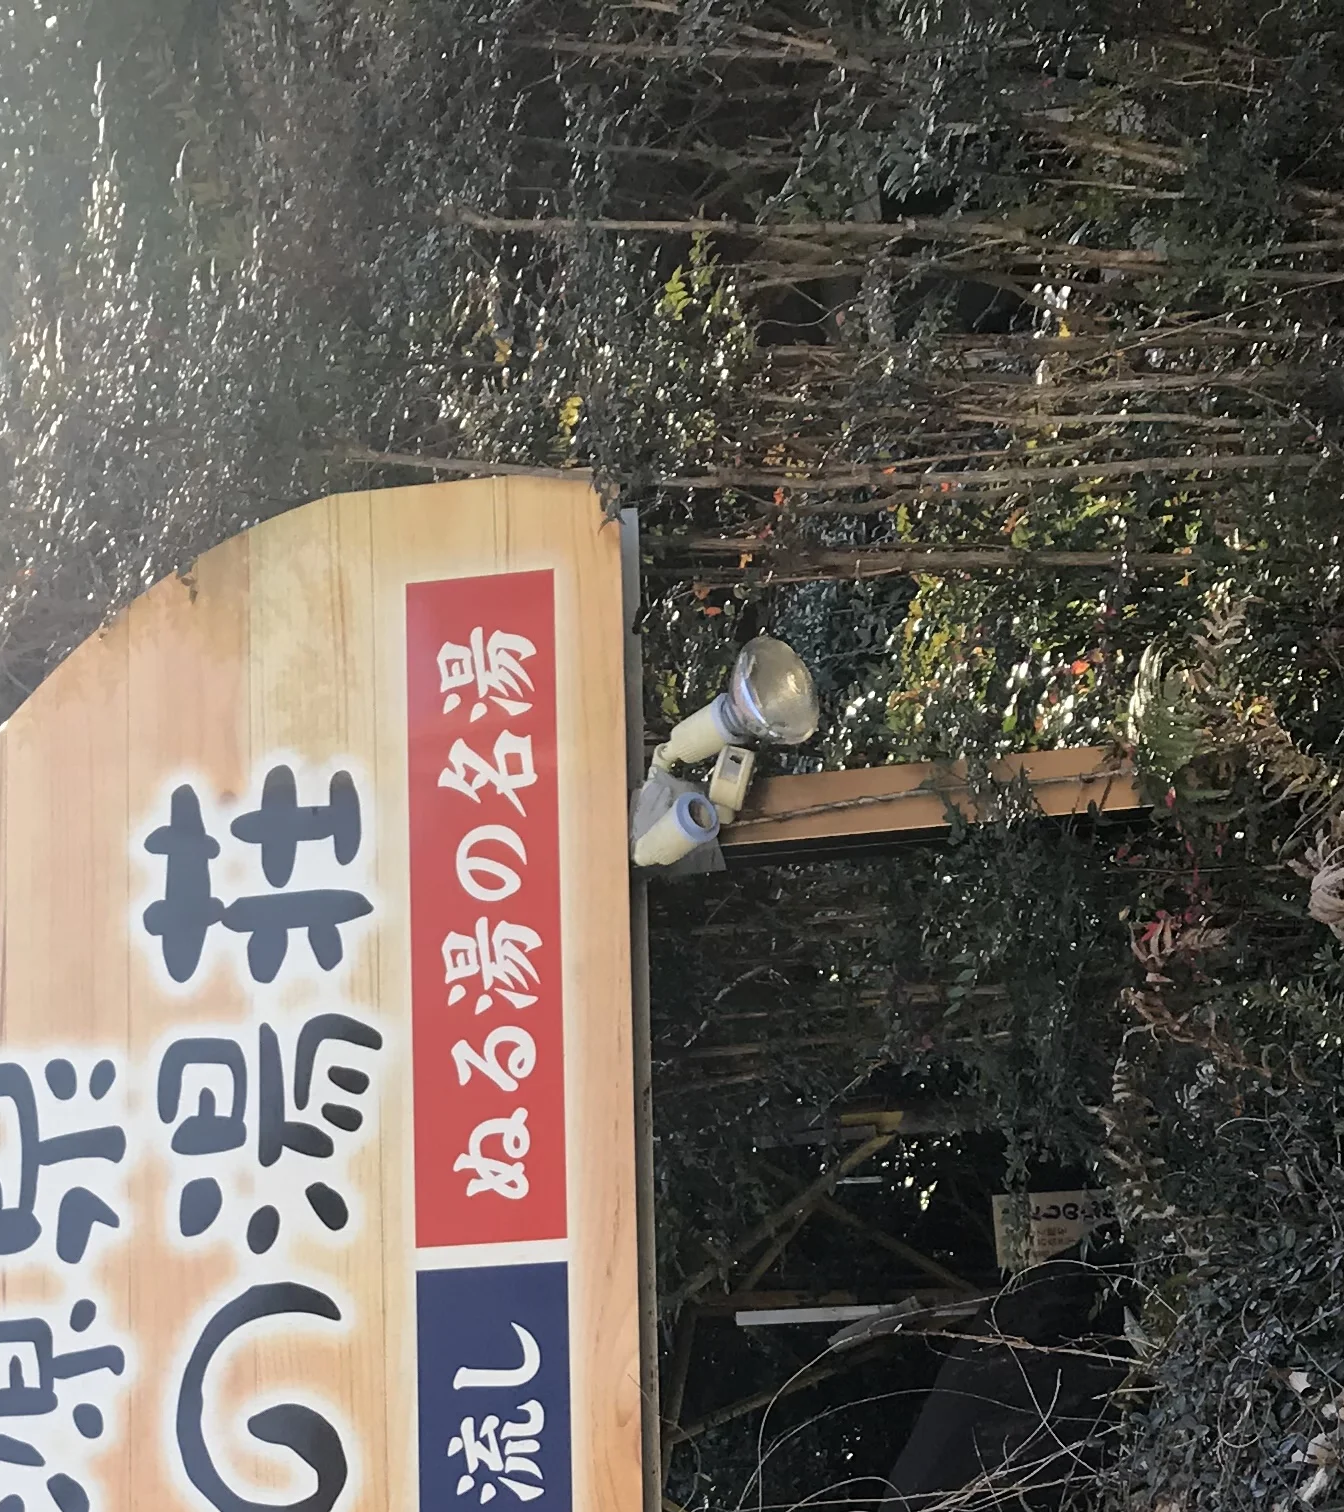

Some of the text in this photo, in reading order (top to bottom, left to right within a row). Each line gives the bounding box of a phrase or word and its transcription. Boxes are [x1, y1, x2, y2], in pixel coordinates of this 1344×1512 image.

[436, 626, 543, 1201] ぬる湯の名湯
